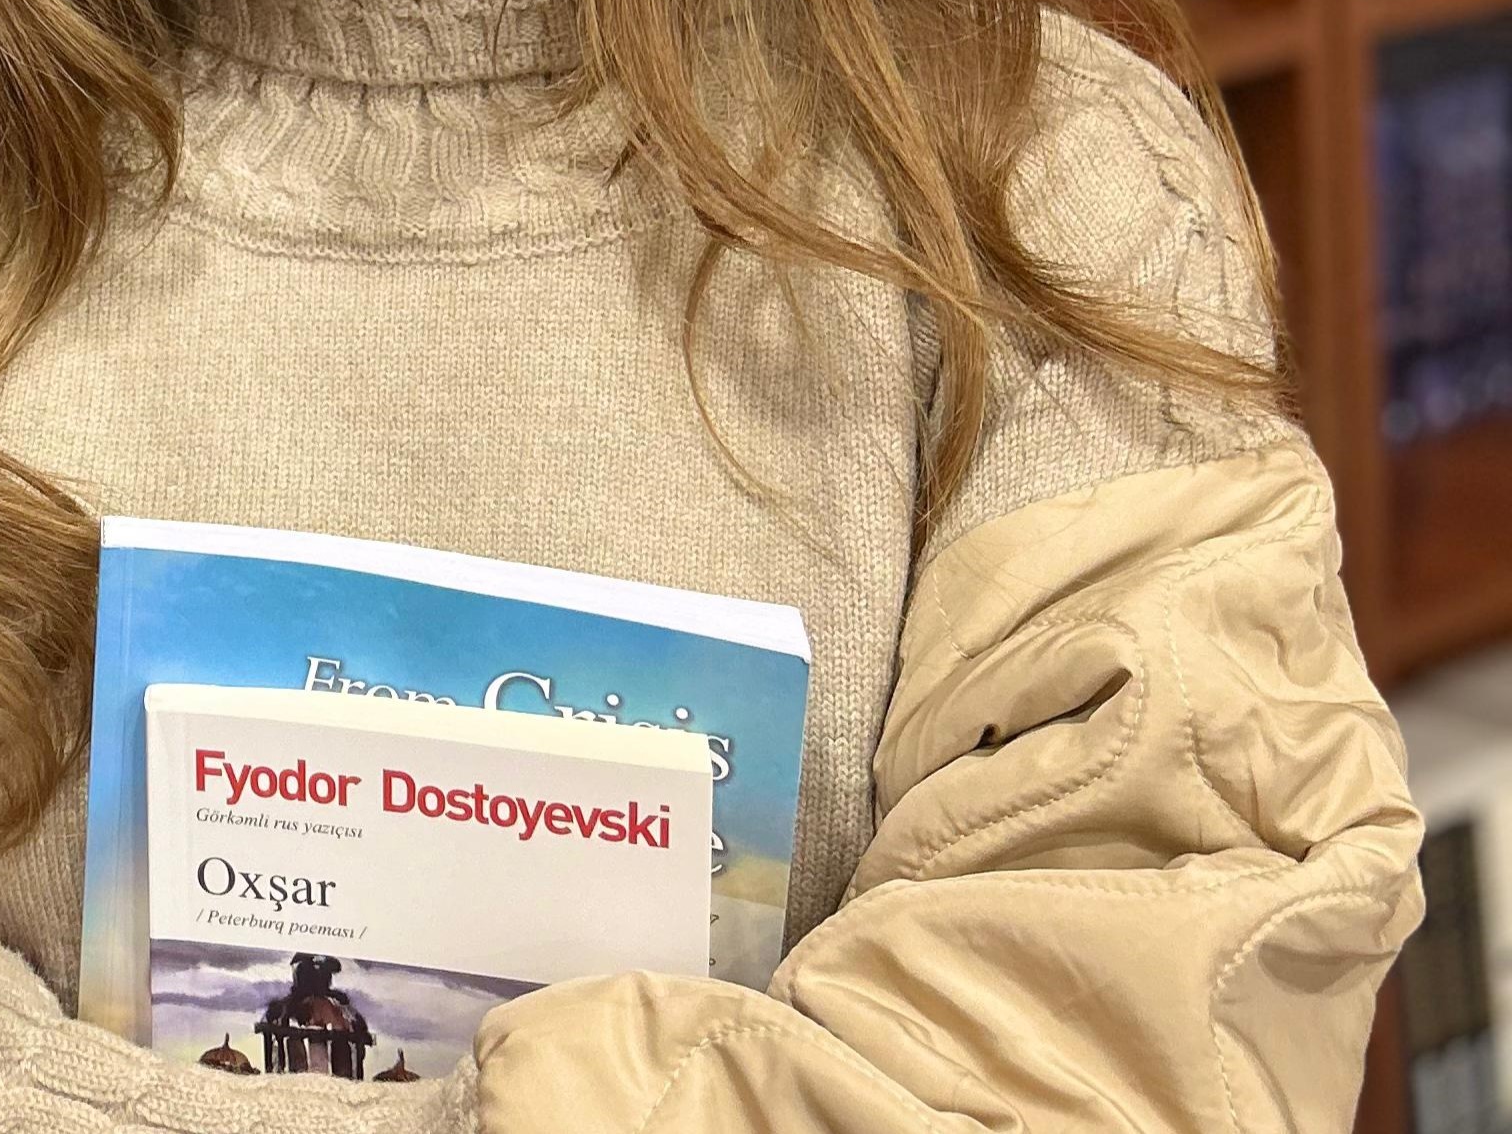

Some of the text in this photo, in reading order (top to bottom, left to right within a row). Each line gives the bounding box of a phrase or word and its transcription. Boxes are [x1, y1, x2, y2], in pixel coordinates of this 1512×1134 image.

[195, 748, 670, 849] Fyodor Dostoyevski
[196, 807, 363, 839] Görkəmli rus yazıçısı
[197, 857, 337, 912] Oxşar
[206, 909, 284, 935] Peterburq
[287, 921, 355, 939] poeması
